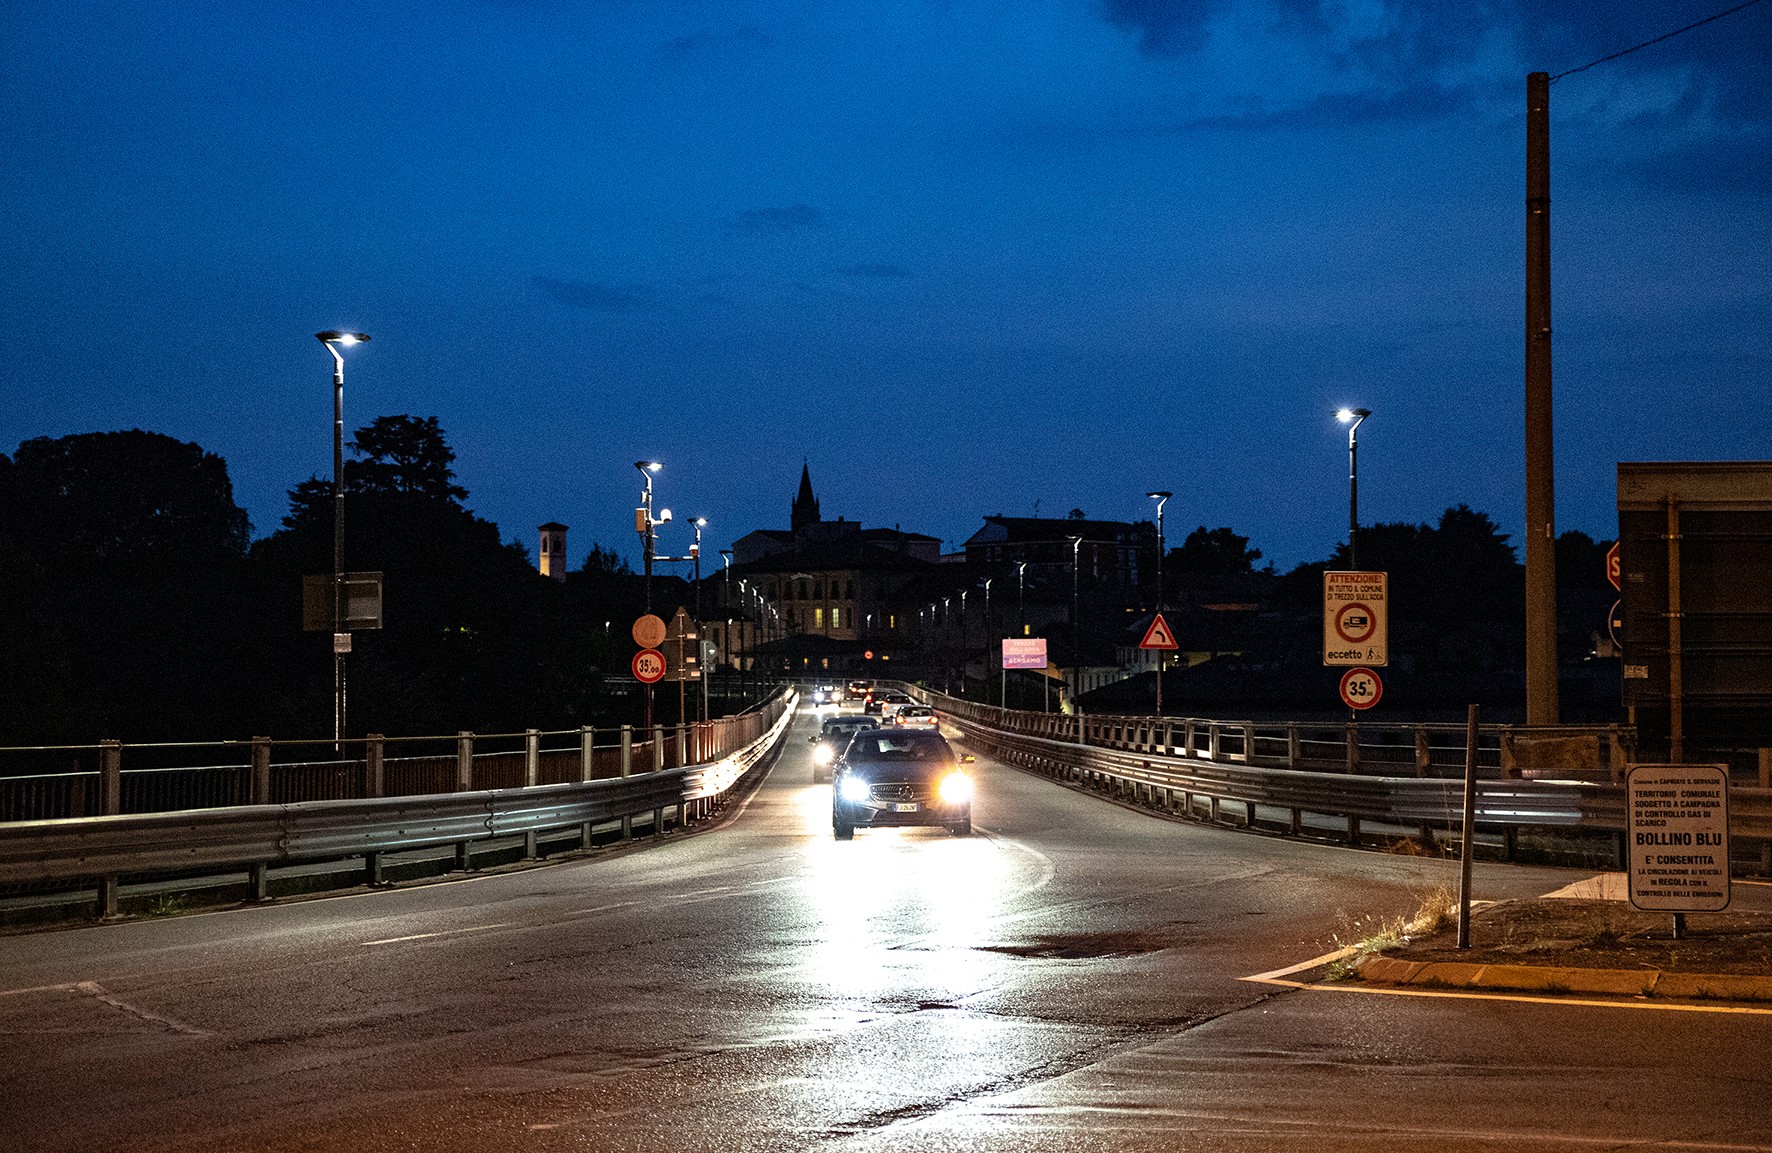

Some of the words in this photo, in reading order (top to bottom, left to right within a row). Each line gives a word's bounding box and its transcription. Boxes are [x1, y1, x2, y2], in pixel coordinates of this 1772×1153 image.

[1330, 575, 1381, 583] ATTENZIONE!
[1328, 650, 1362, 659] eccetto
[1636, 833, 1691, 845] BOLLINO
[1696, 833, 1722, 846] BLU
[1646, 855, 1654, 864] E'
[1657, 856, 1714, 864] CONSENTITA
